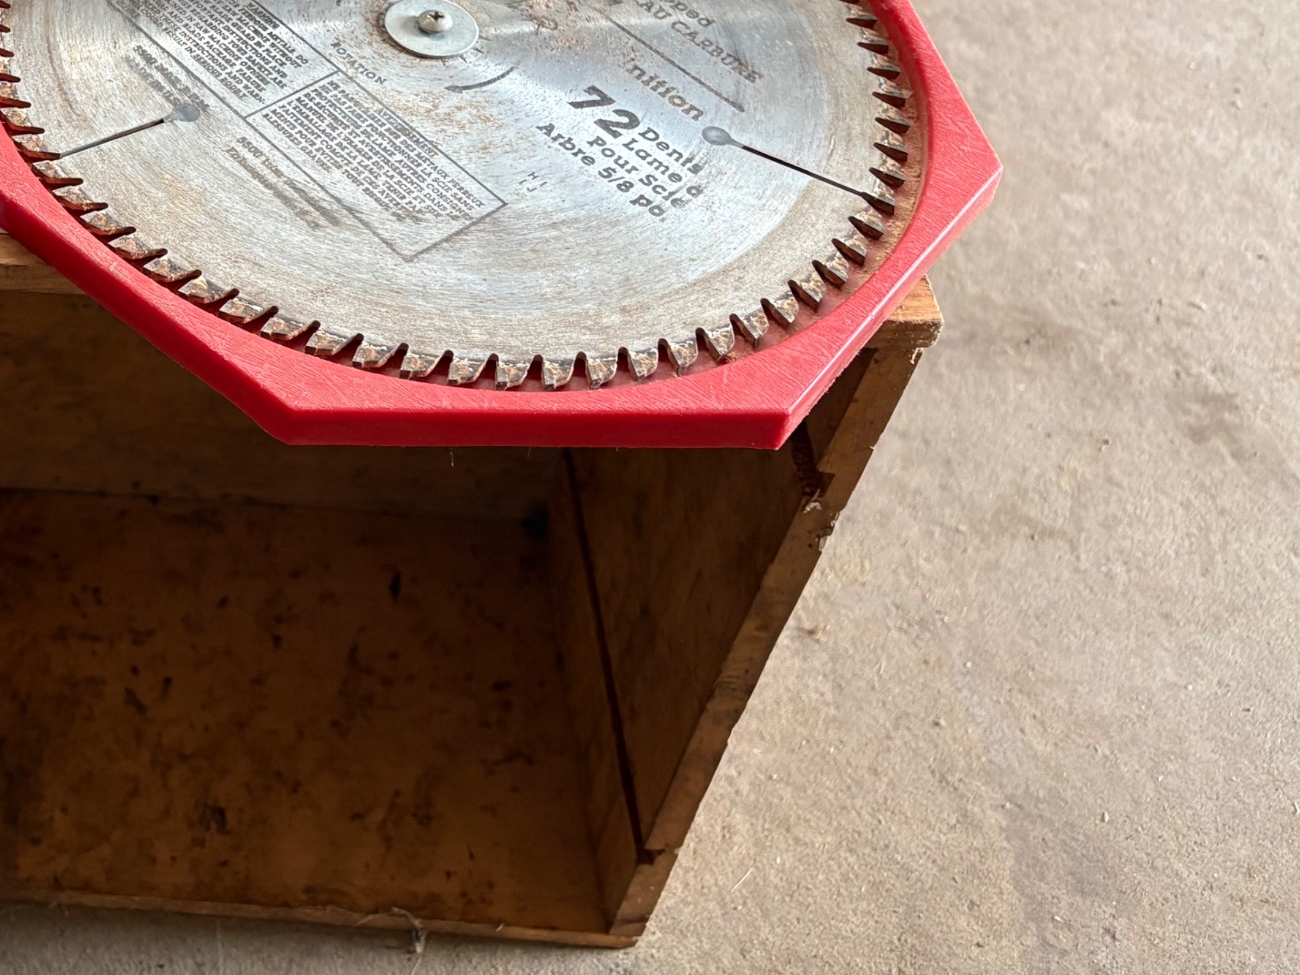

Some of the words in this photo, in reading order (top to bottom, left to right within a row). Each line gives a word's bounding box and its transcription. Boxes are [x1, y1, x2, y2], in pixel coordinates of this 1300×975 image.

[166, 10, 184, 23] AND
[234, 68, 266, 93] FAILURE
[189, 9, 229, 40] REGARDING
[192, 21, 209, 34] SAW
[206, 34, 242, 61] MACHINE
[220, 24, 272, 65] INSTRUCTIONS
[268, 64, 288, 79] AND
[221, 4, 238, 17] SAW
[266, 42, 303, 69] WITHOUT
[229, 22, 256, 41] GUARD
[664, 19, 769, 84] CARBURE
[177, 30, 228, 71] INSTRUCTIONS
[224, 70, 244, 85] AND
[325, 40, 390, 87] ROTATION
[269, 108, 298, 130] MENTS
[294, 129, 317, 147] POUR
[340, 169, 365, 188] TOUT
[277, 104, 322, 140] FAITEMENT
[318, 139, 353, 167] COMPTE
[361, 175, 381, 190] CES
[294, 97, 328, 123] MANUEL
[393, 179, 415, 195] SCIE
[398, 139, 417, 153] DES
[534, 120, 602, 167] Arbre
[595, 165, 637, 194] 5/8
[565, 84, 641, 139] 72
[635, 126, 708, 175] Dents
[364, 122, 423, 168] FONCTIONNER
[431, 176, 453, 193] SCIE
[449, 191, 476, 211] SANS
[394, 157, 428, 183] AUTRES
[584, 134, 644, 176] Pour
[635, 172, 691, 210] Scie
[619, 137, 689, 185] Lame
[381, 180, 407, 201] TENIR
[422, 191, 449, 213] DANS
